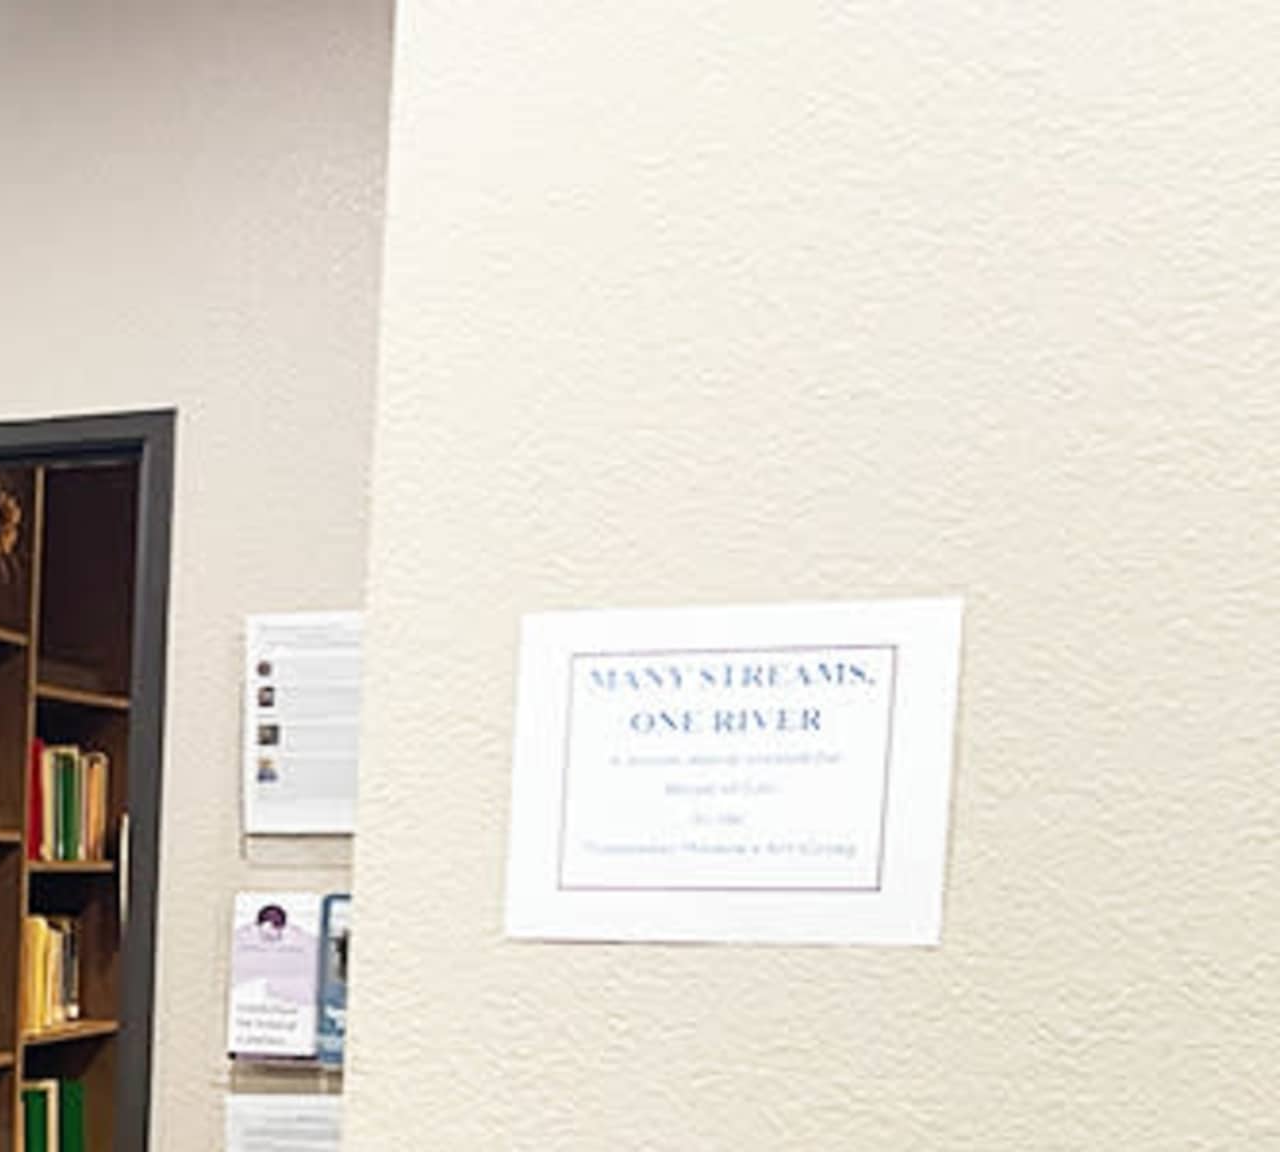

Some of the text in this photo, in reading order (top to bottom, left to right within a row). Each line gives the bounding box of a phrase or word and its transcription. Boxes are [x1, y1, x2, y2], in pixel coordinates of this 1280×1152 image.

[590, 664, 689, 690] MANY
[629, 707, 822, 733] ONE RIVER
